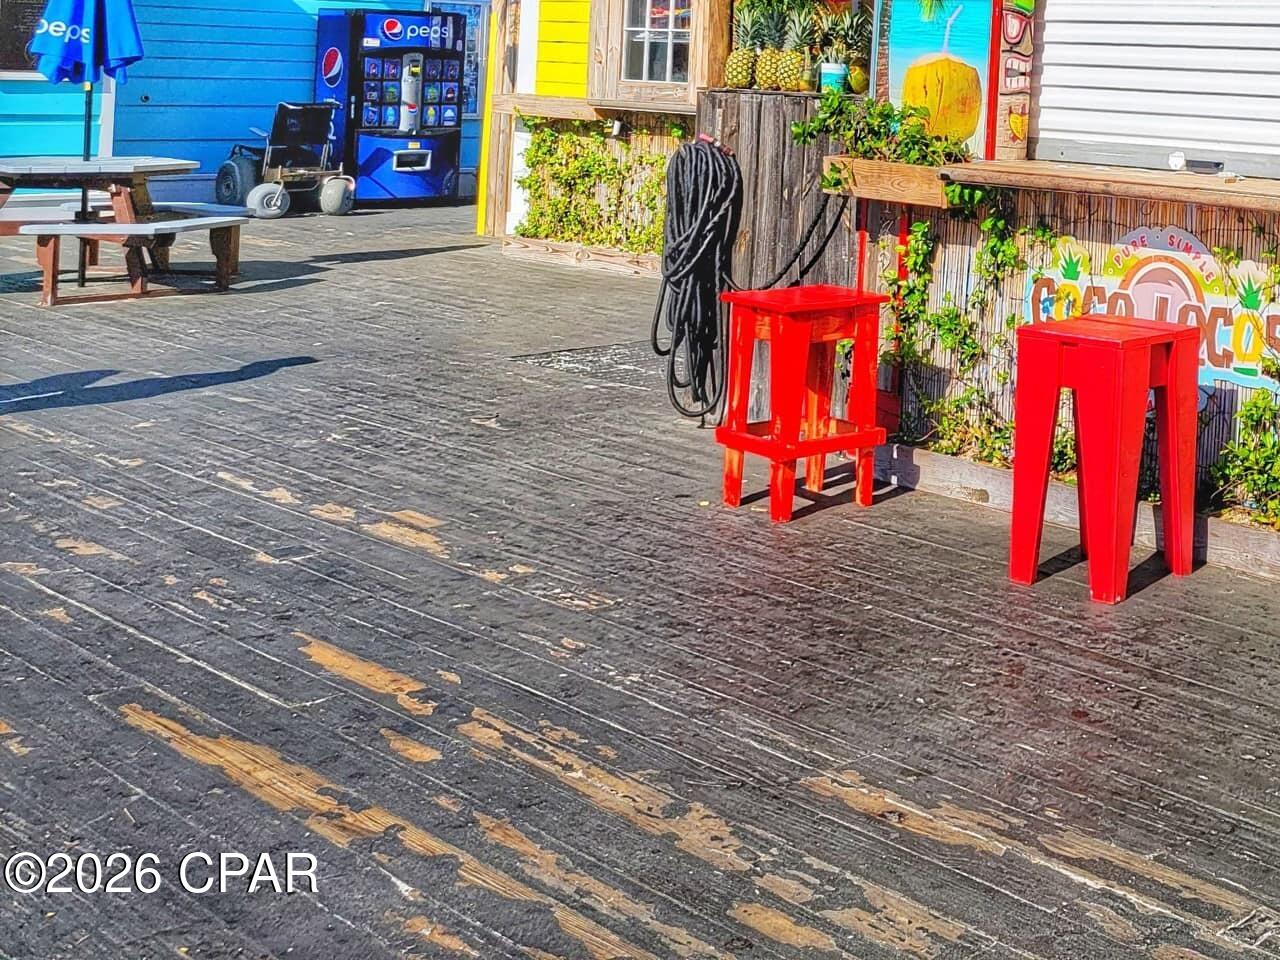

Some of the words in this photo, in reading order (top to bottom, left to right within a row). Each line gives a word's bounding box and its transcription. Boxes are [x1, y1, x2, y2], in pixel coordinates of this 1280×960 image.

[36, 19, 91, 44] eps
[407, 25, 449, 40] peps
[1113, 235, 1147, 266] PURE
[1168, 234, 1215, 281] SIMPLE
